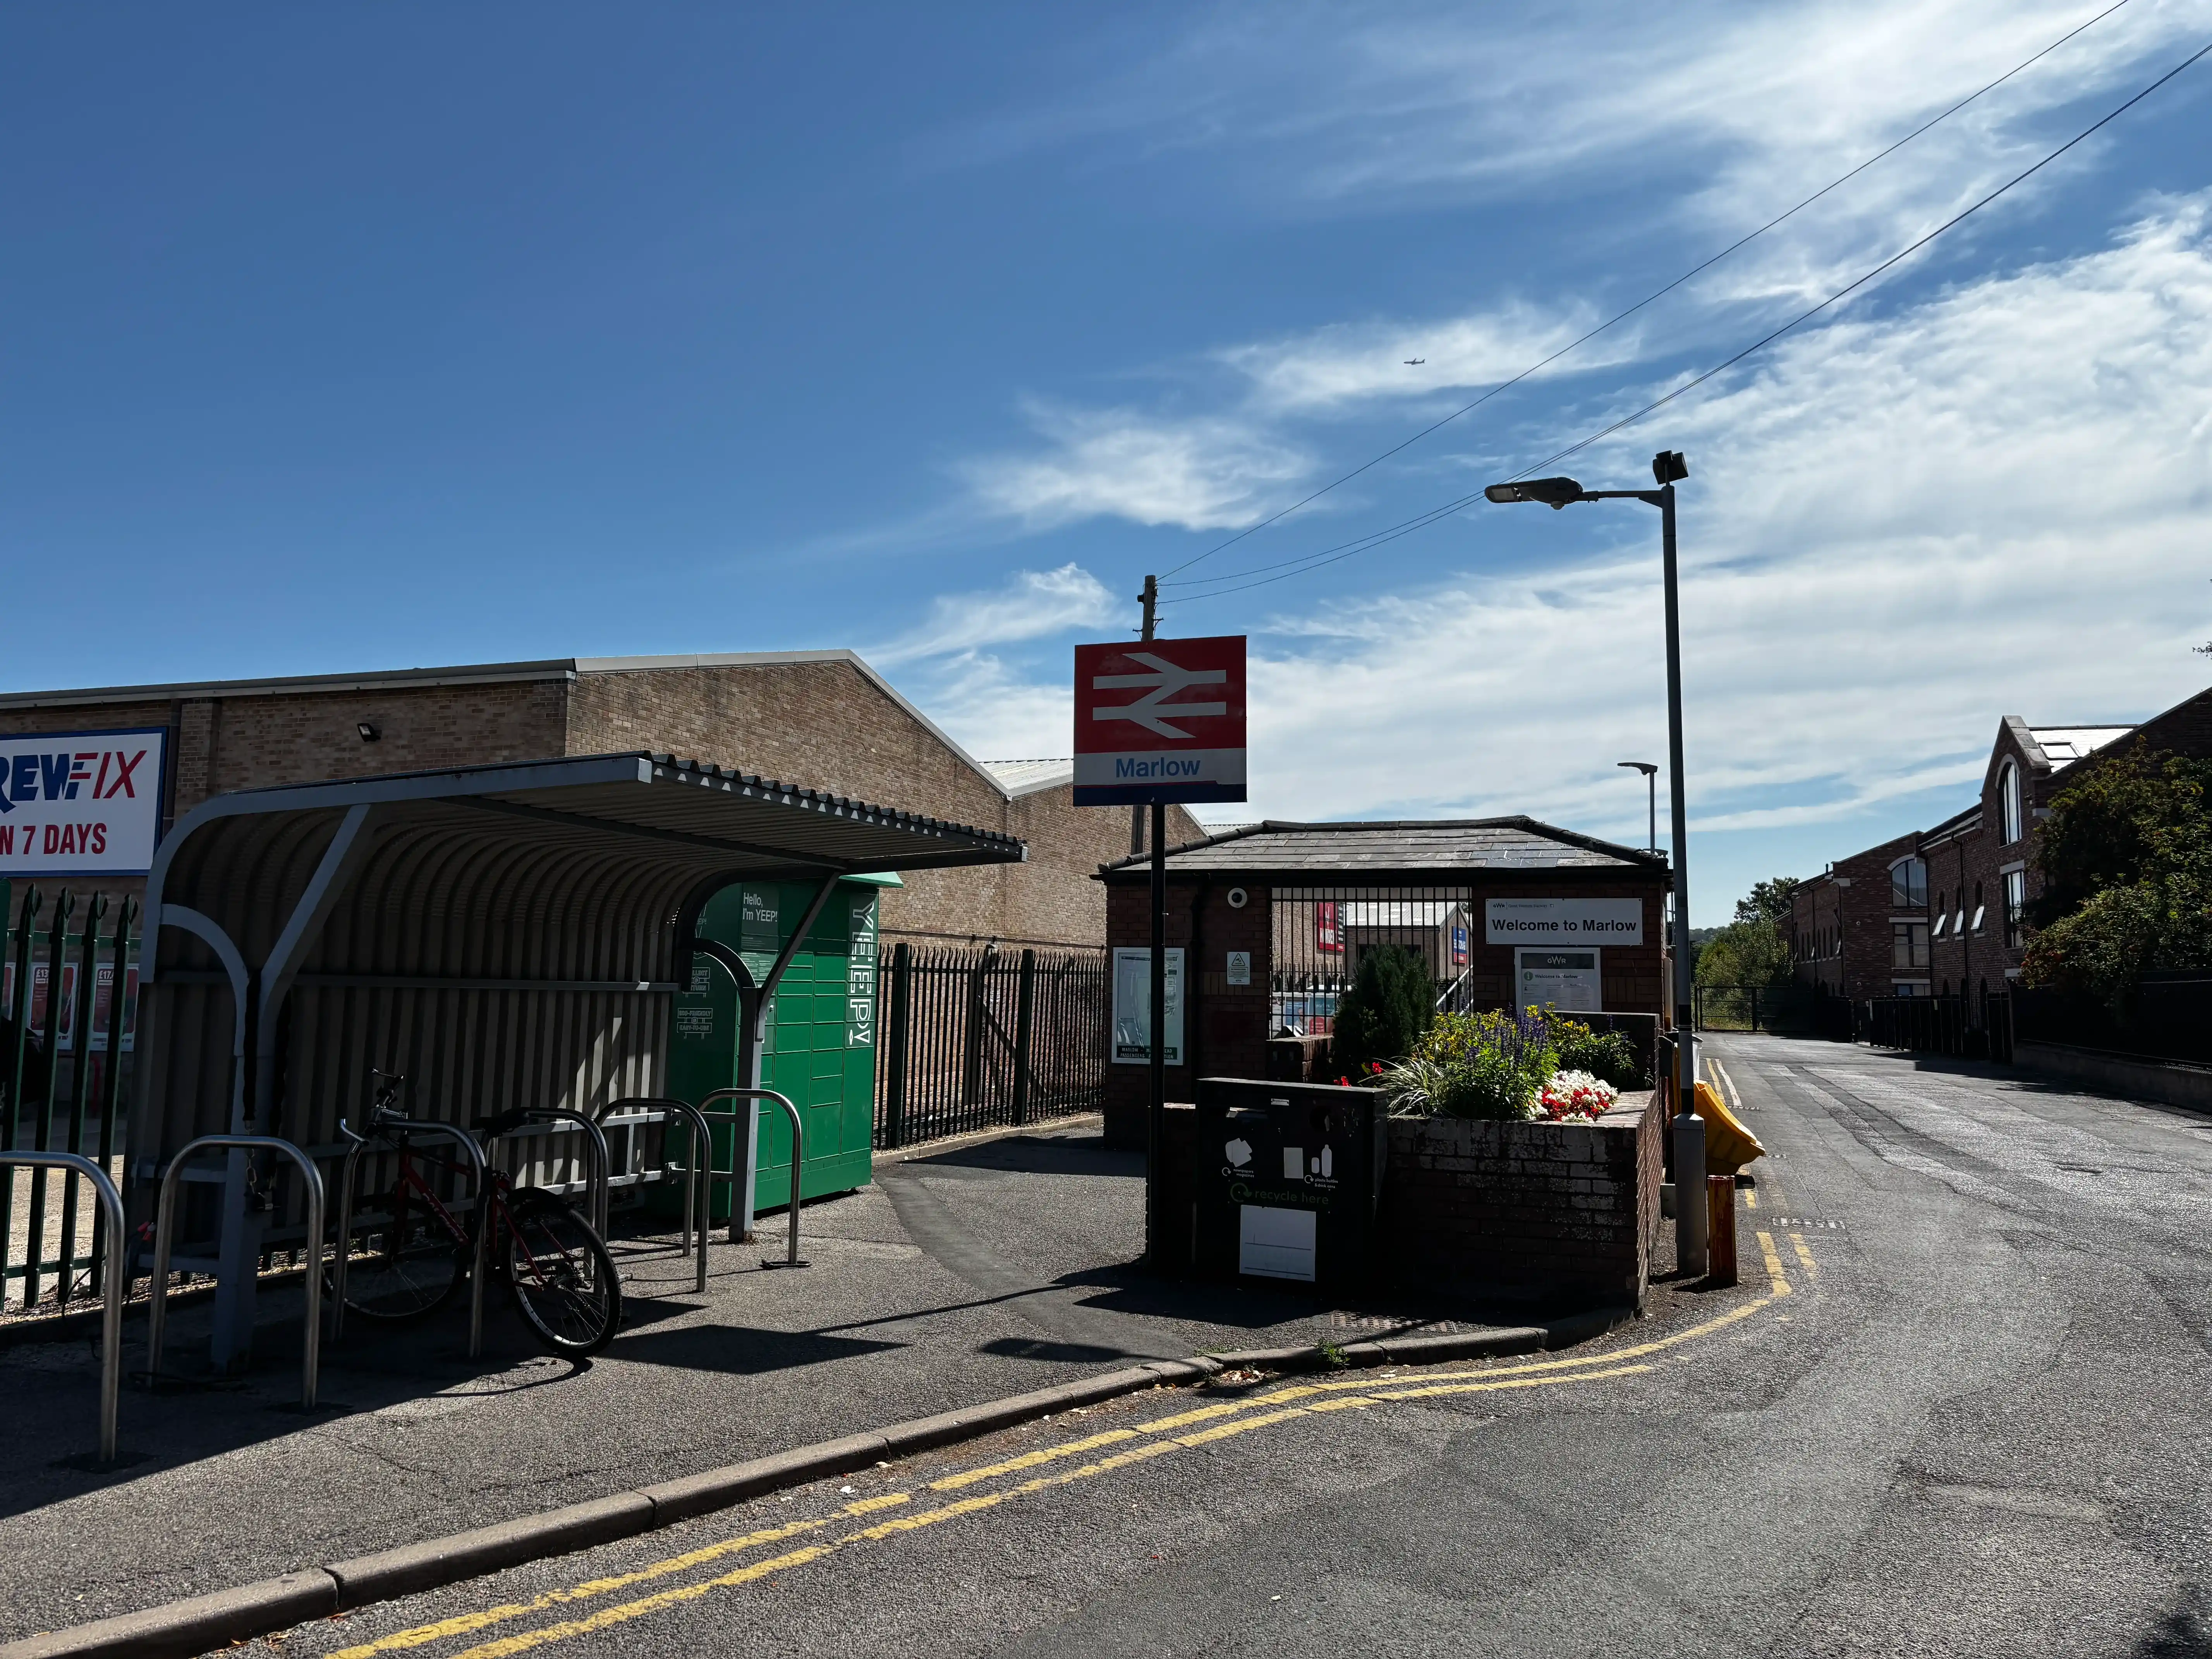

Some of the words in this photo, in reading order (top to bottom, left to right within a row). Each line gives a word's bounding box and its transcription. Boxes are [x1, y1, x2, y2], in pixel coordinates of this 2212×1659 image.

[1116, 757, 1200, 778] Marlow
[22, 826, 36, 855] 7
[43, 823, 107, 855] DAYS
[743, 892, 763, 908] Hello,
[743, 908, 754, 921] I'm
[755, 909, 778, 922] YEEP!
[1492, 919, 1559, 931] Welcome
[1563, 919, 1578, 931] to
[1583, 919, 1637, 931] Marlow
[1547, 955, 1566, 965] GWR
[849, 900, 874, 1046] YEEP!
[1255, 1190, 1297, 1202] recycle
[1302, 1192, 1329, 1204] here
